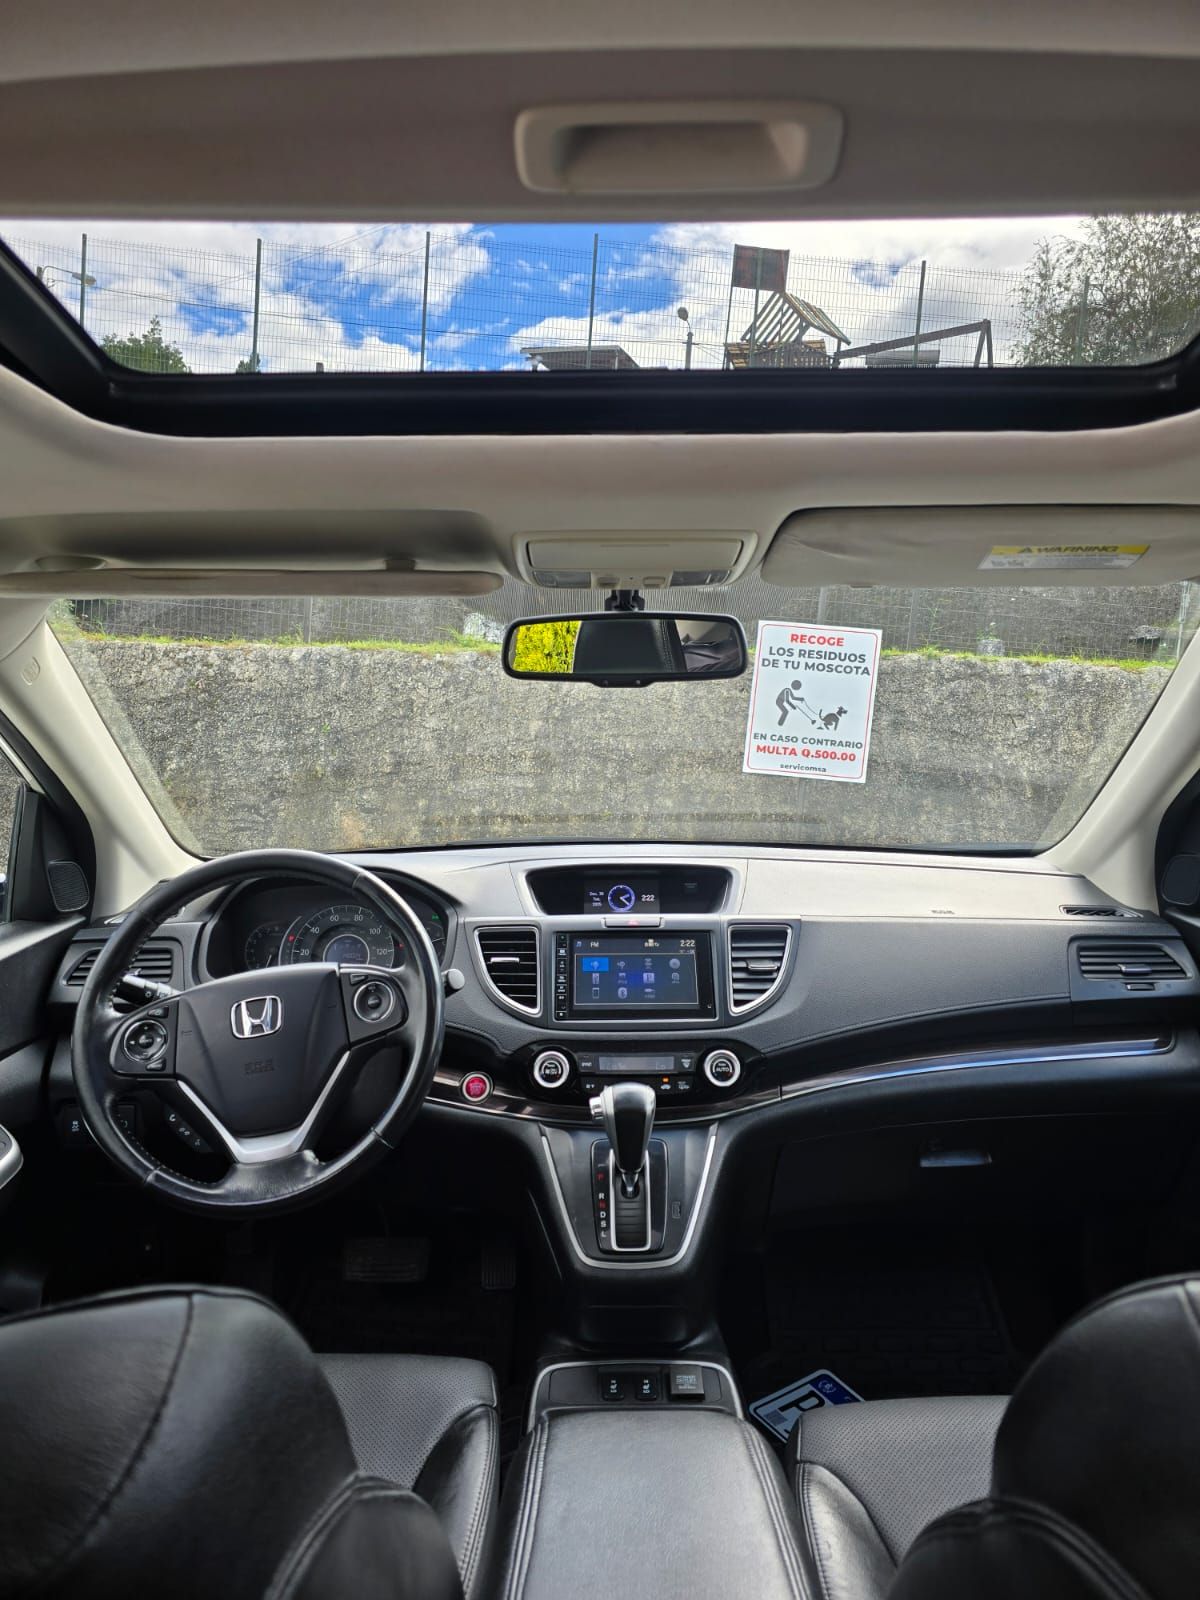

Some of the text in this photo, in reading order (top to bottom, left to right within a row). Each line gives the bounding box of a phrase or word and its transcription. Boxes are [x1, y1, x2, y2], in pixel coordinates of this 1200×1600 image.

[1037, 545, 1119, 553] WARNING
[790, 633, 844, 647] RECOGE
[769, 646, 866, 663] LOS RESIDUOS
[761, 658, 871, 676] DE TU MOSCOTA
[753, 732, 863, 749] EN CASO CONTRARIO
[756, 744, 856, 762] MULTA Q.500.00
[780, 763, 827, 773] servicomsa
[329, 914, 340, 922] 60
[353, 914, 364, 922] 80
[310, 926, 320, 934] 40
[680, 939, 696, 947] 2:22
[300, 948, 310, 956] 20
[600, 1220, 607, 1228] S
[601, 1230, 607, 1238] L
